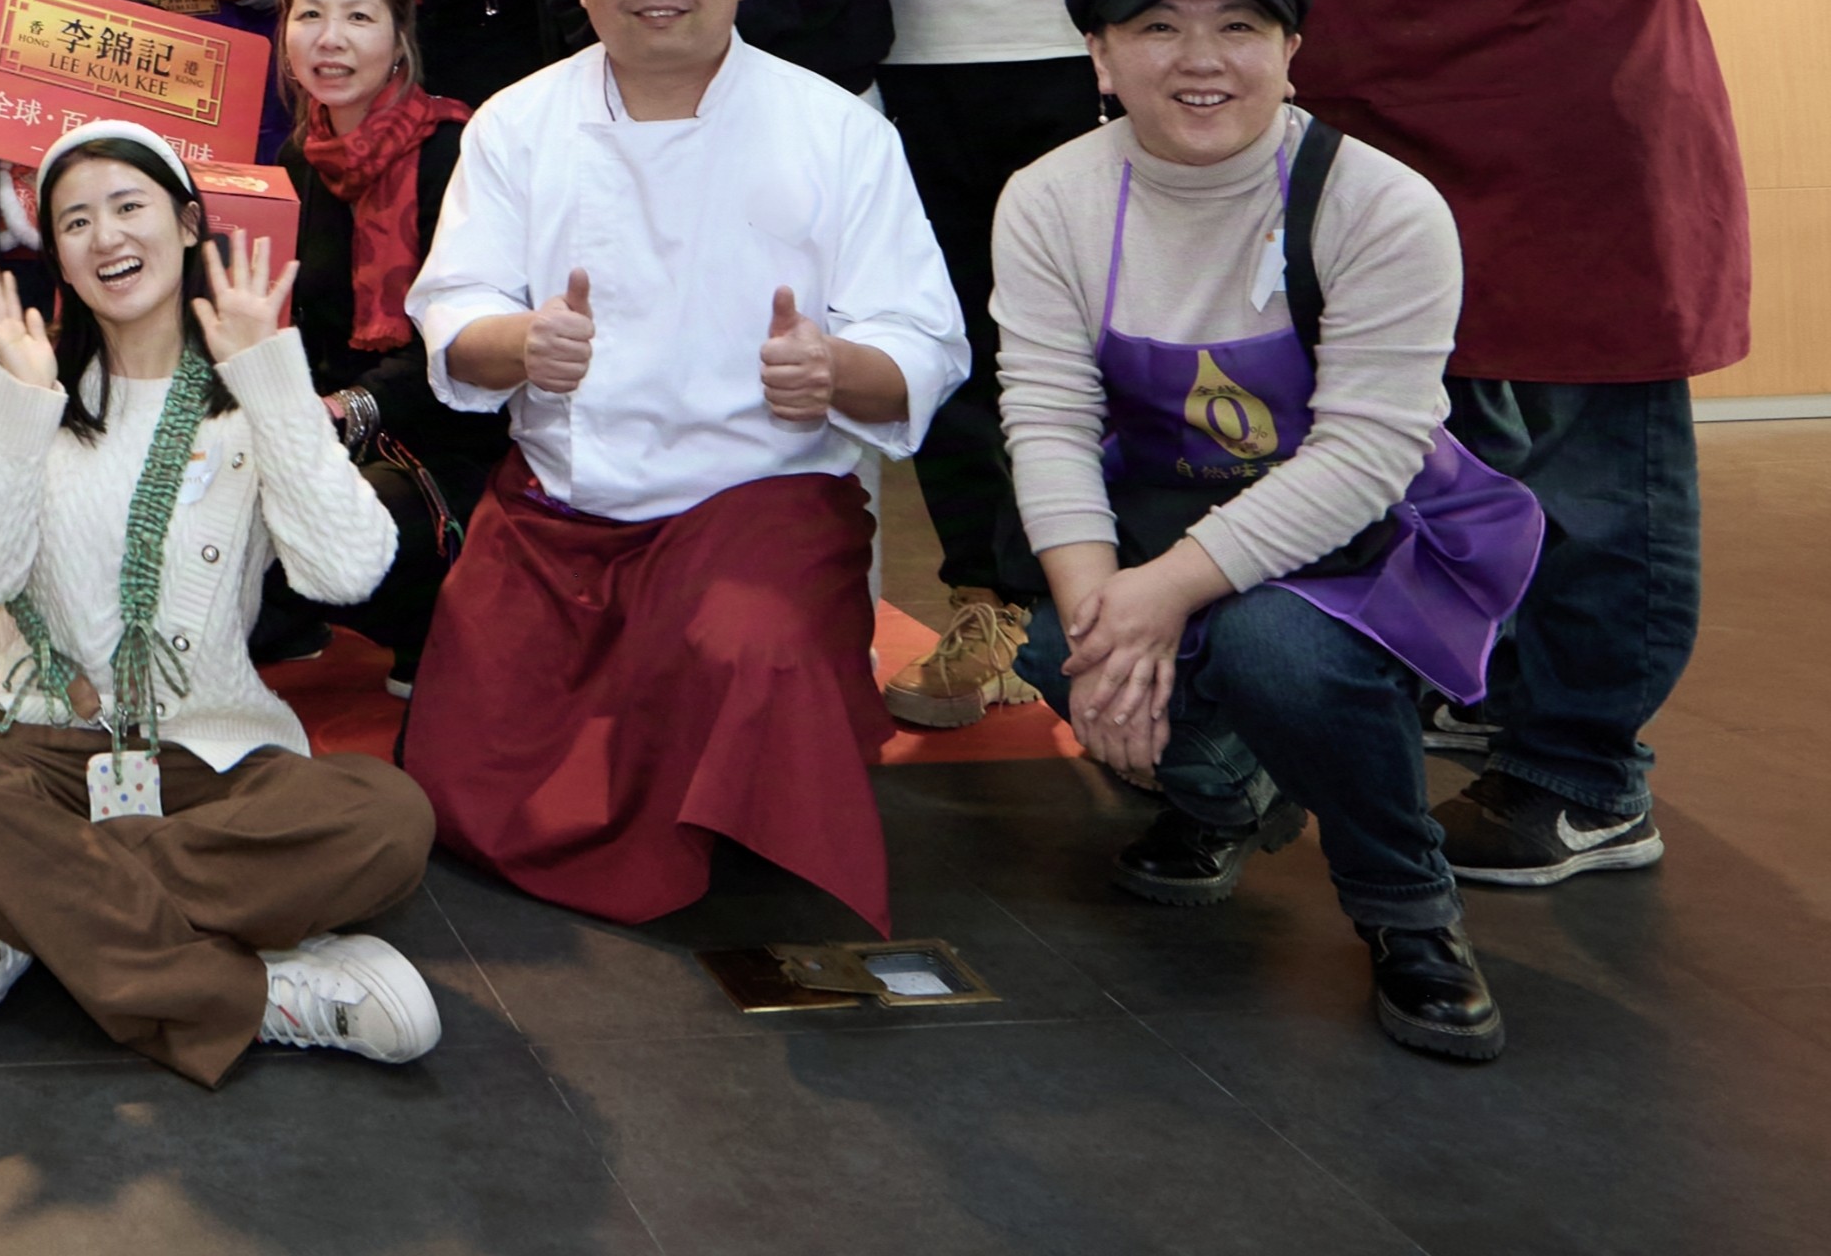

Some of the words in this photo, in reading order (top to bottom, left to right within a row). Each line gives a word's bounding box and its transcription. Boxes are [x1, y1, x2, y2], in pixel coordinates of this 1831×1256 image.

[18, 33, 50, 49] HONG
[30, 20, 44, 35] 香
[57, 18, 174, 77] 李錦記
[184, 60, 199, 77] 港
[49, 53, 79, 74] LEE
[86, 63, 129, 87] KUM
[135, 76, 169, 97] KEE
[175, 72, 204, 88] KONG
[1176, 457, 1282, 479] 自然味
